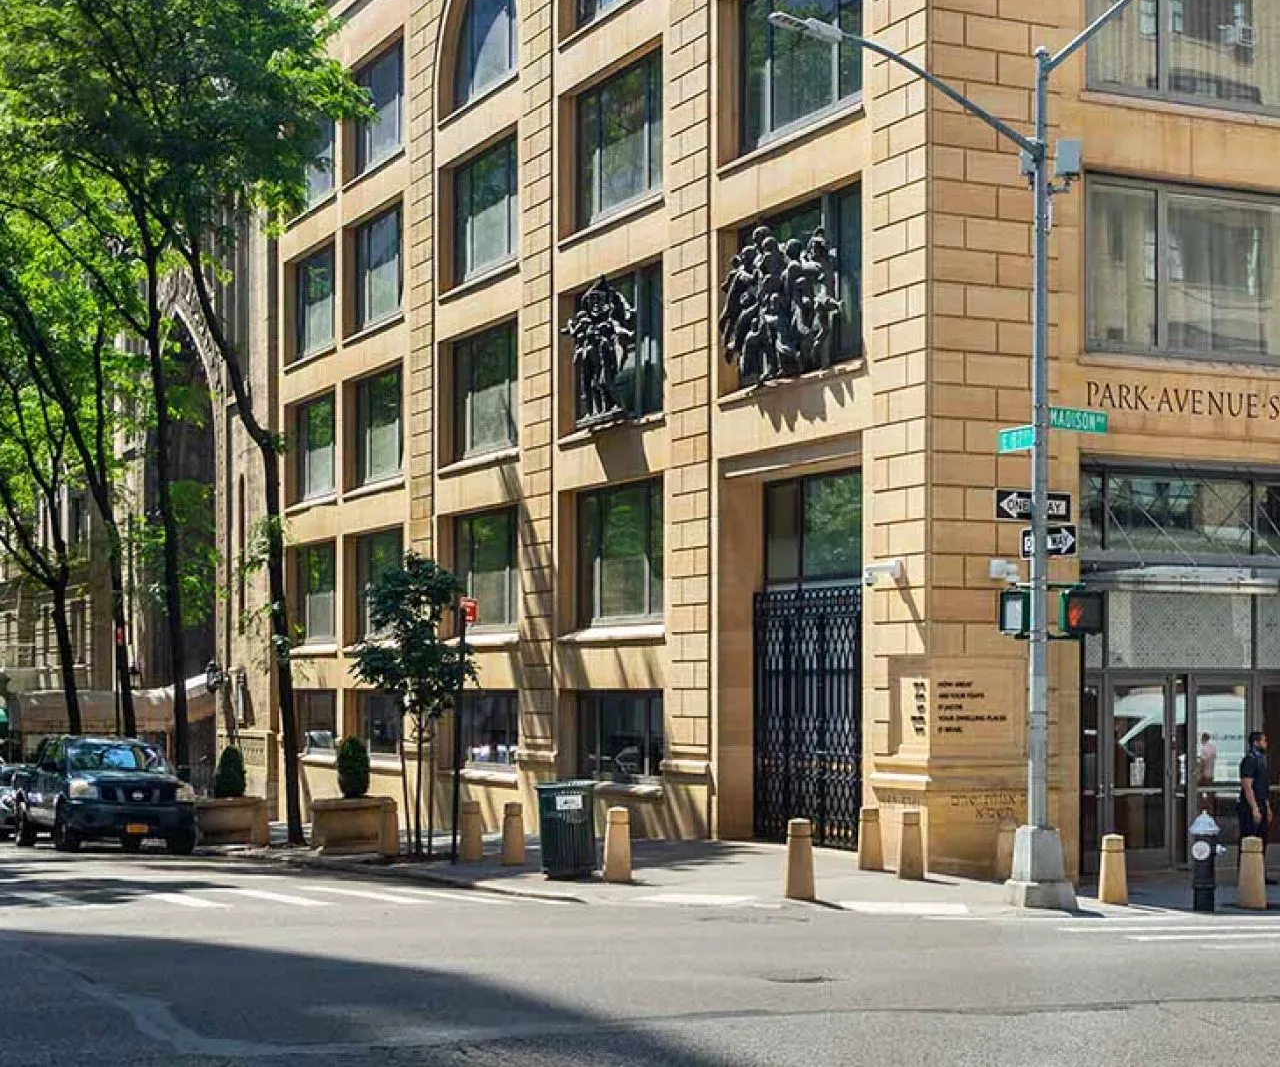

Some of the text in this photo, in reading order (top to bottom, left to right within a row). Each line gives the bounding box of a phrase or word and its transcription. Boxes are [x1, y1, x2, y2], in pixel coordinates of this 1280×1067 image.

[1086, 380, 1150, 412] PARK
[1156, 387, 1260, 420] AVENUE
[1050, 408, 1096, 431] MADISON
[1007, 498, 1030, 512] ONE
